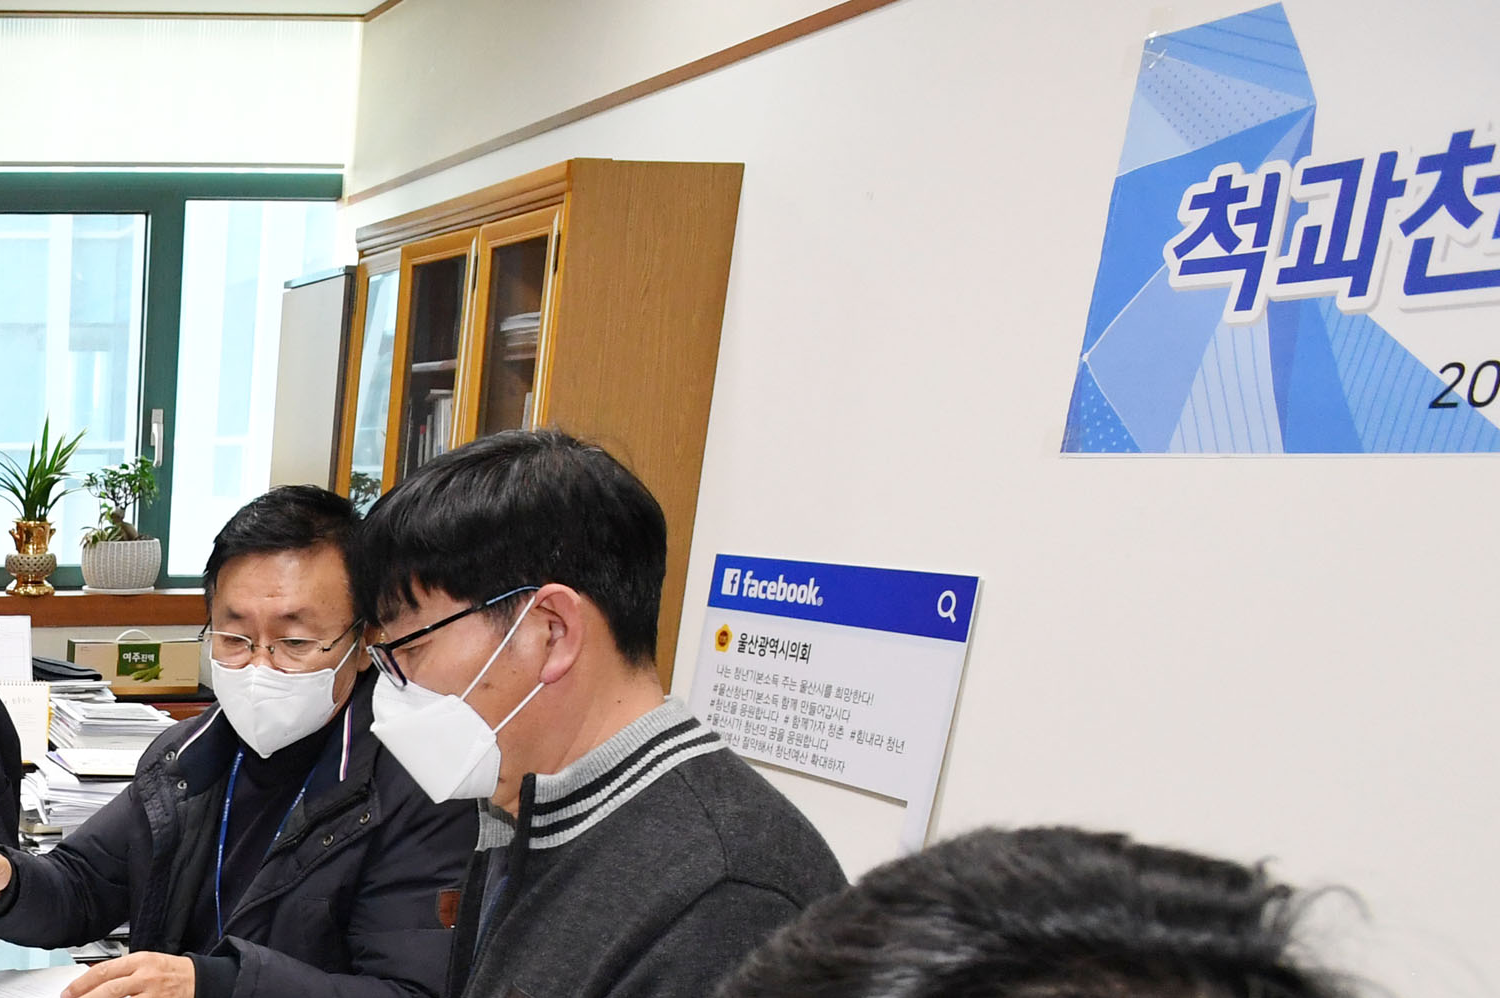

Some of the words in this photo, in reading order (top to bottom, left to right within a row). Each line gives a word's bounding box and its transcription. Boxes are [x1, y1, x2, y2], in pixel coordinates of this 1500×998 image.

[742, 570, 819, 606] facebook
[737, 632, 812, 664] 울산광역시의회
[716, 664, 732, 679] 나는
[734, 666, 779, 687] 청년기본소득
[781, 676, 798, 691] 주는
[799, 680, 833, 698] 울산시를
